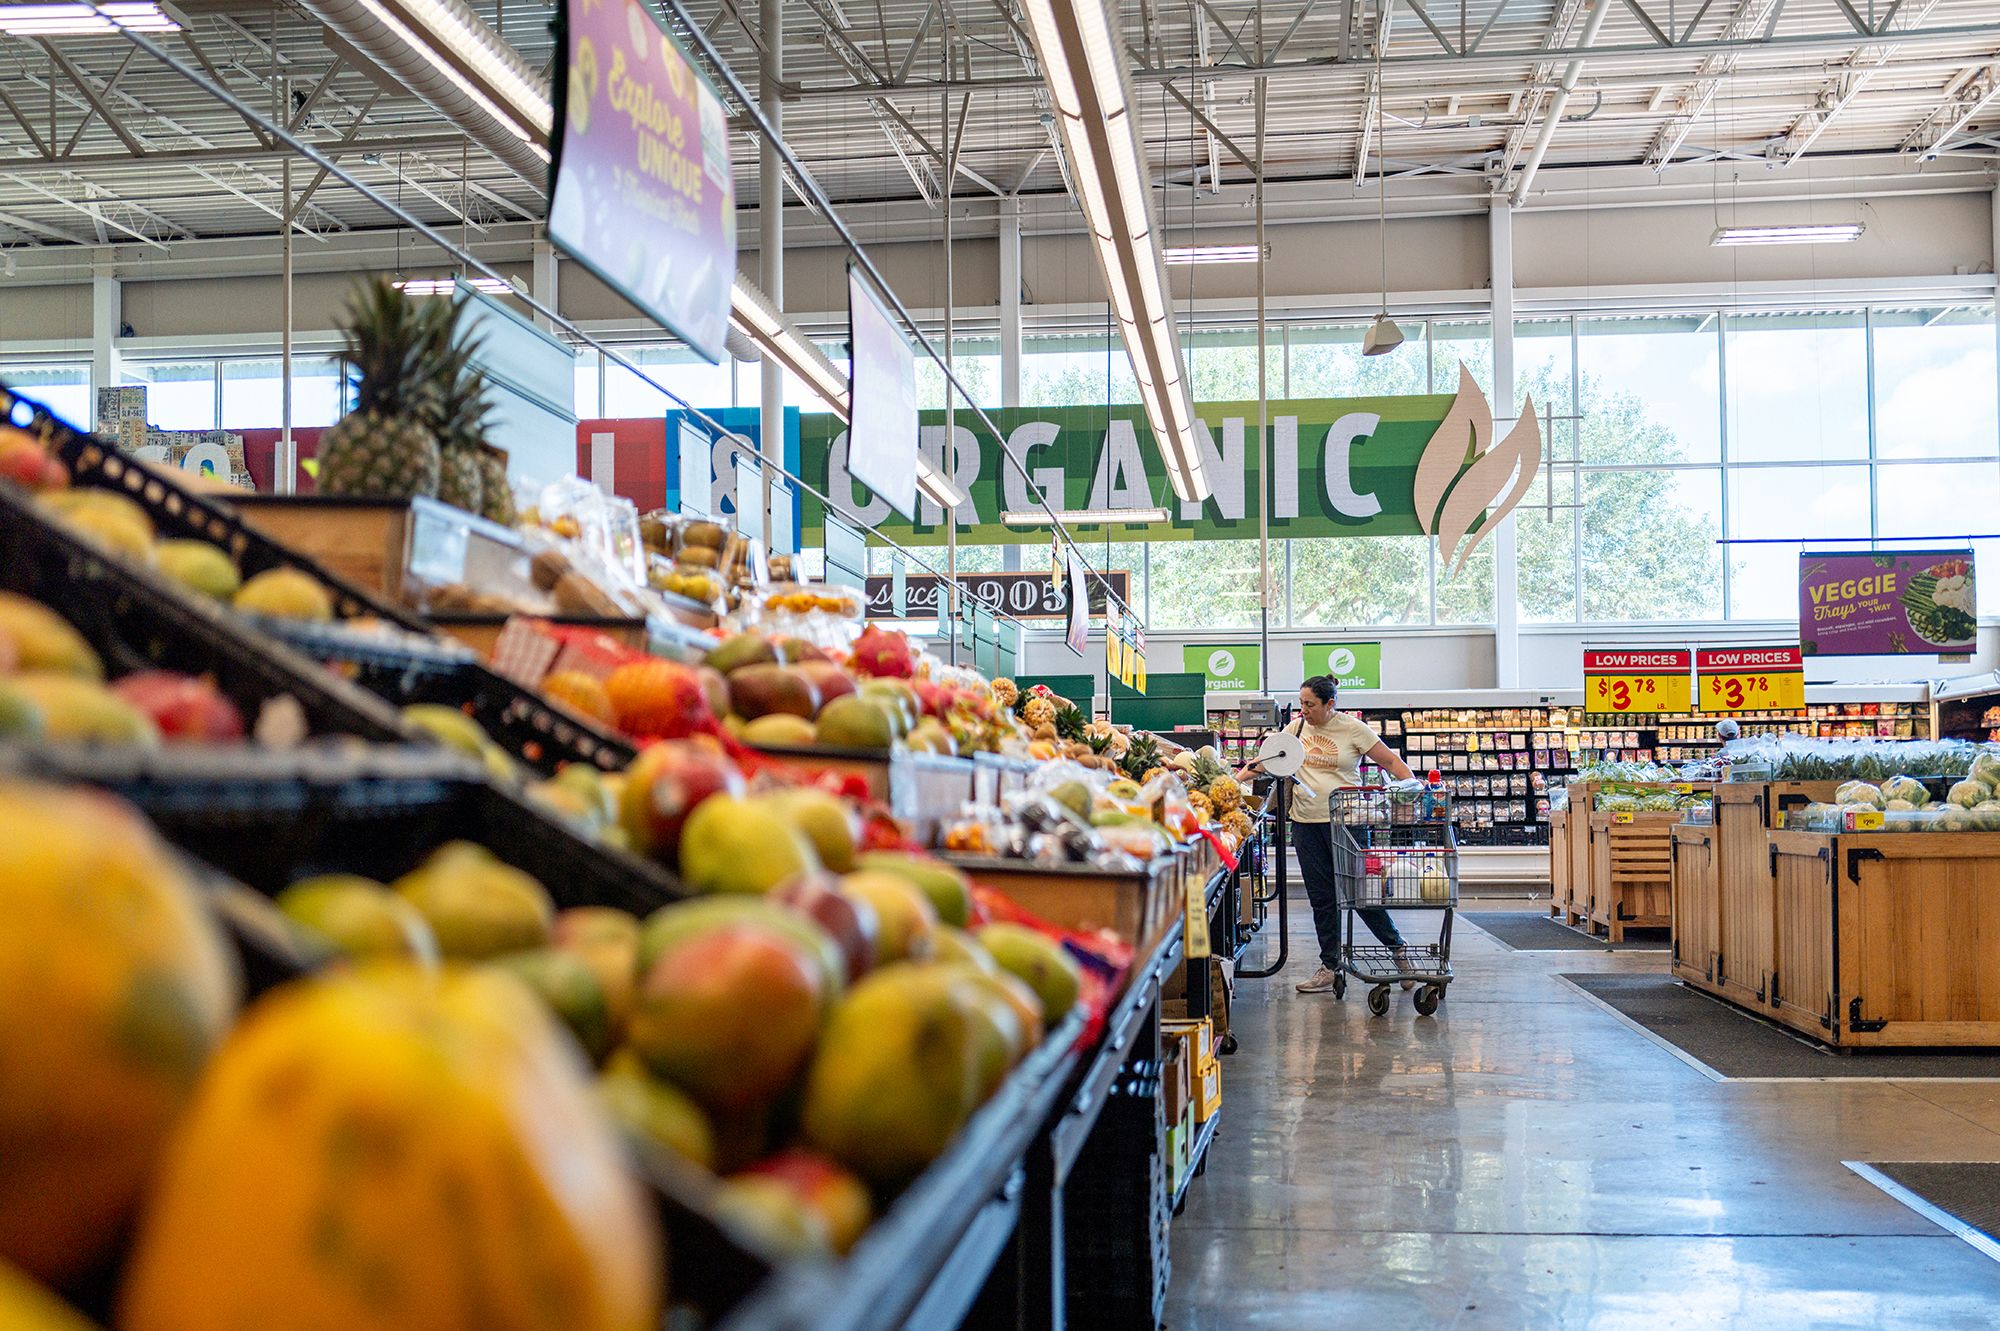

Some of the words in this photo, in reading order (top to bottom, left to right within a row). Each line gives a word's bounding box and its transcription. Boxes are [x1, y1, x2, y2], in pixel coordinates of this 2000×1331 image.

[608, 46, 685, 149] Explore
[638, 129, 703, 205] UNIQUE
[828, 412, 1382, 528] ORGANIC
[870, 583, 938, 606] snce
[1808, 573, 1897, 604] VEGGIE
[1813, 603, 1857, 620] Trays
[1857, 599, 1879, 608] YOUR
[1874, 603, 1892, 612] WAY
[1595, 655, 1627, 666] LOW
[1630, 654, 1678, 665] PRICES
[1708, 653, 1741, 665] LOW
[1743, 652, 1791, 664] PRICES
[1205, 678, 1245, 689] rganic
